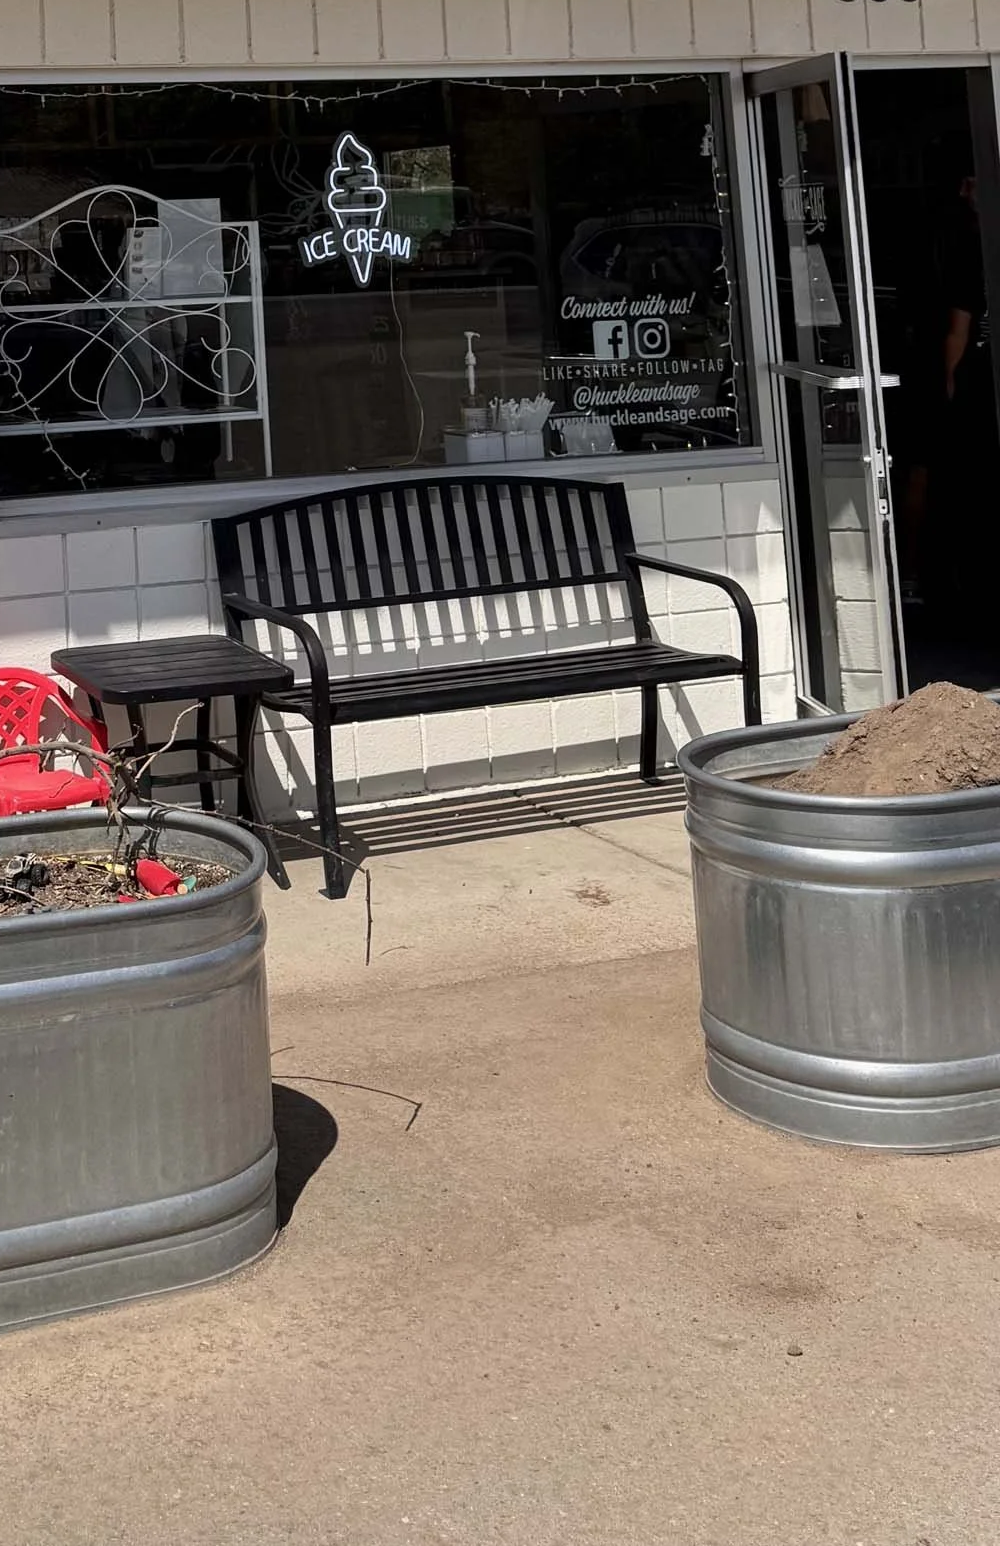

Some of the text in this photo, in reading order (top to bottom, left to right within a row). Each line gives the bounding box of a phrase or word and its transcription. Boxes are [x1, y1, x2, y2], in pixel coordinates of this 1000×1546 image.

[303, 227, 411, 263] ICE CREAM
[560, 291, 696, 320] Connect with us!
[573, 380, 700, 410] @huckleandsage
